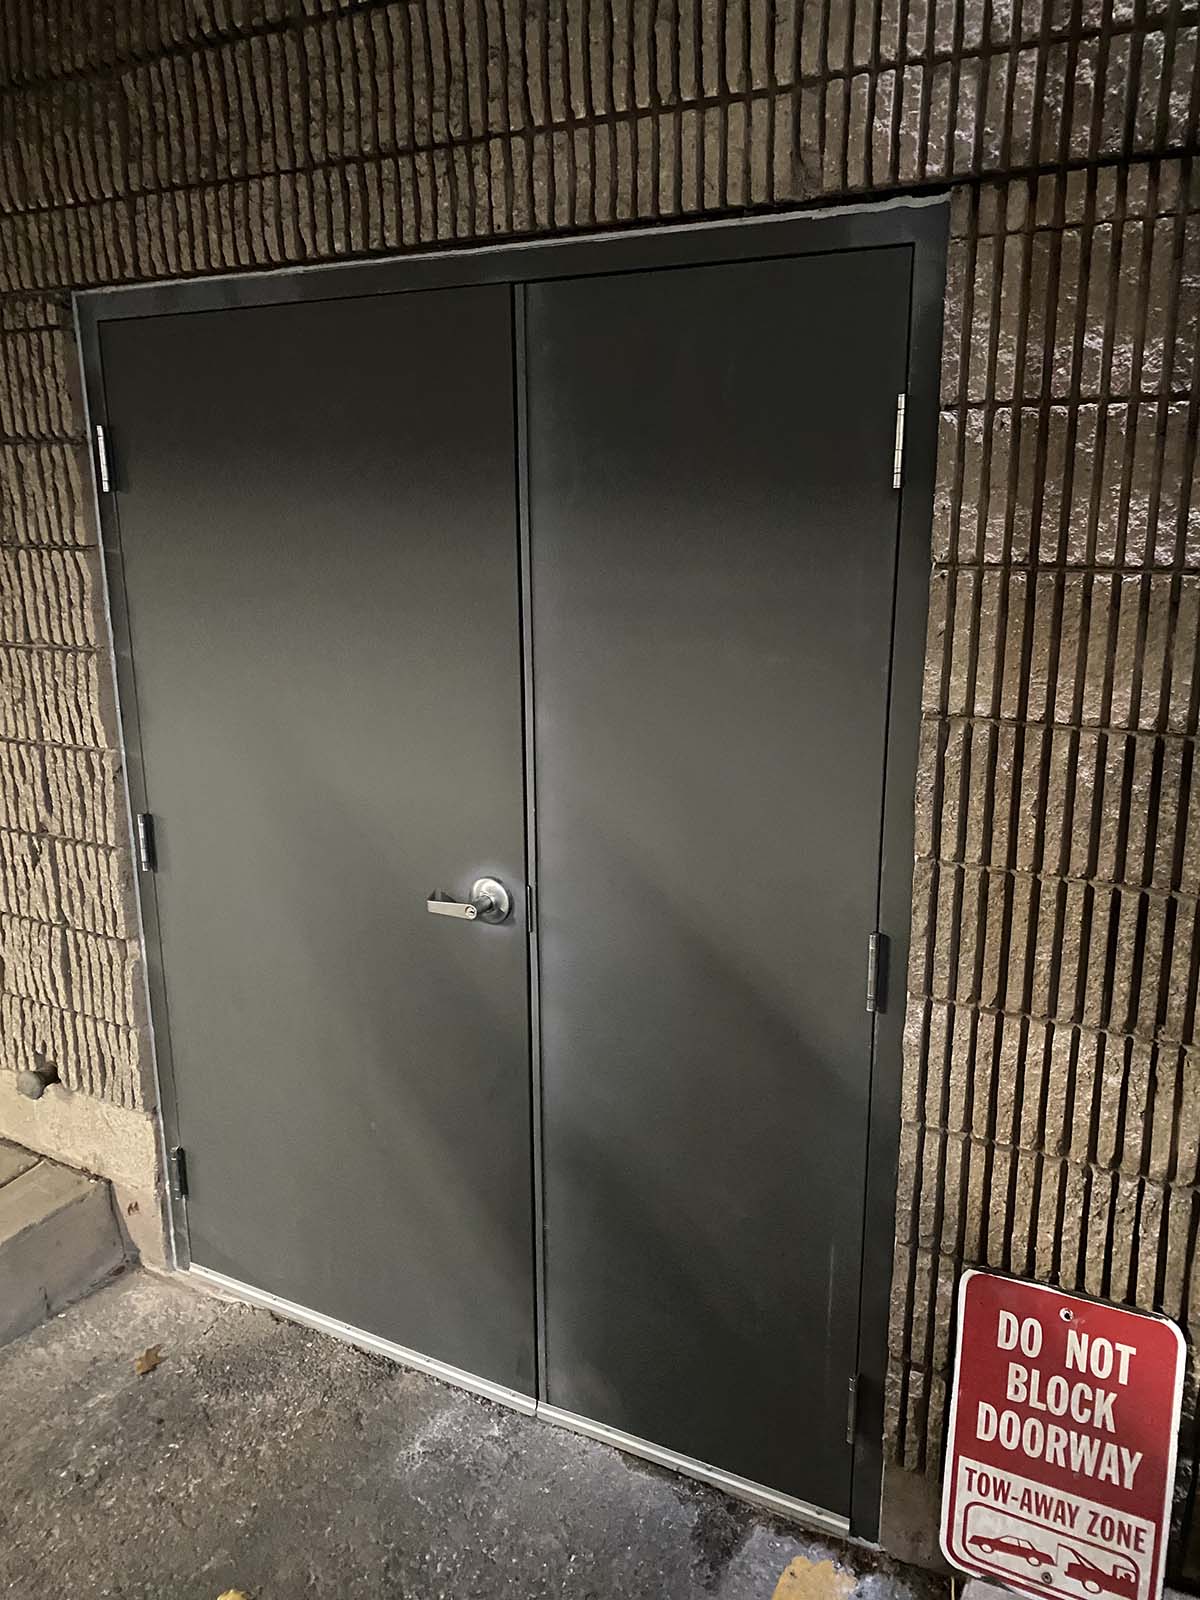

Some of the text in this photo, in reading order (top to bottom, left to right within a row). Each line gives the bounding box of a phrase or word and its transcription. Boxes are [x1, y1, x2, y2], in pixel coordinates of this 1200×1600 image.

[997, 1309, 1137, 1385] DO NOT
[1006, 1361, 1117, 1433] BLOCK
[975, 1401, 1143, 1490] DOORWAY
[964, 1465, 1147, 1554] TOW-AWAY ZONE
